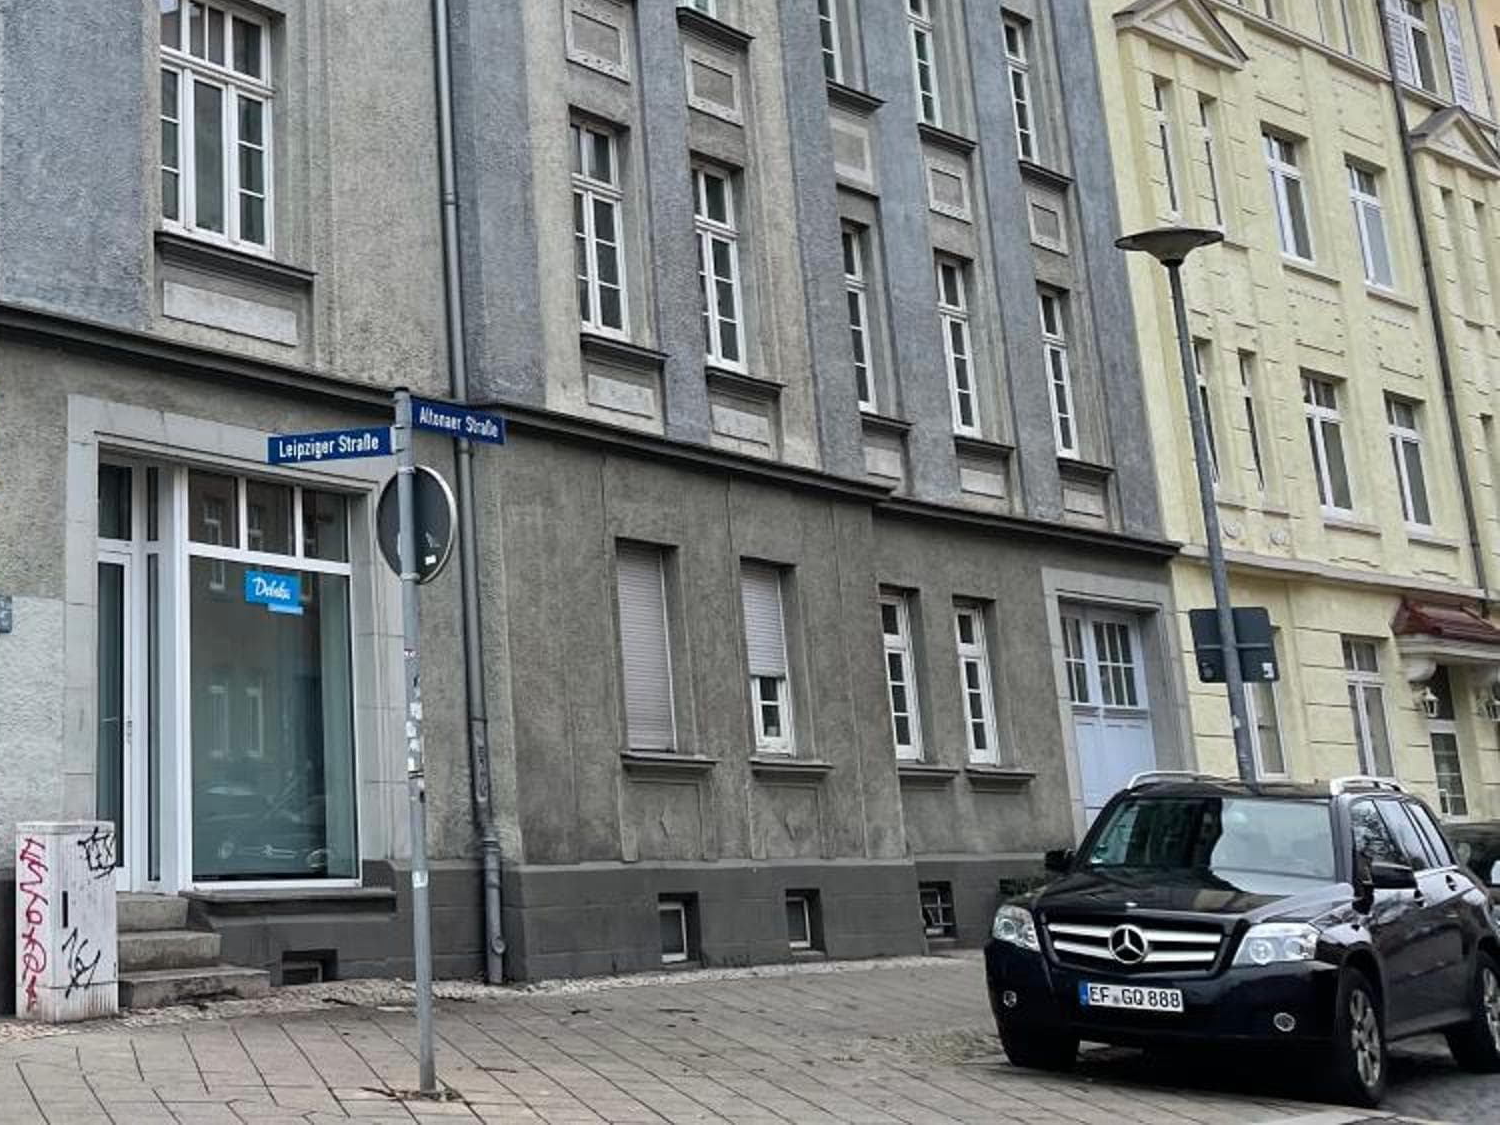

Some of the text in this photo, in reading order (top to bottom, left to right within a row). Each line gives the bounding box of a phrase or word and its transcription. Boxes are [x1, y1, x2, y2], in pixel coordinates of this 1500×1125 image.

[418, 406, 499, 438] Altonaer Straße
[278, 432, 379, 460] Leipziger Straße
[1089, 986, 1110, 1004] EF
[1147, 990, 1181, 1008] 888
